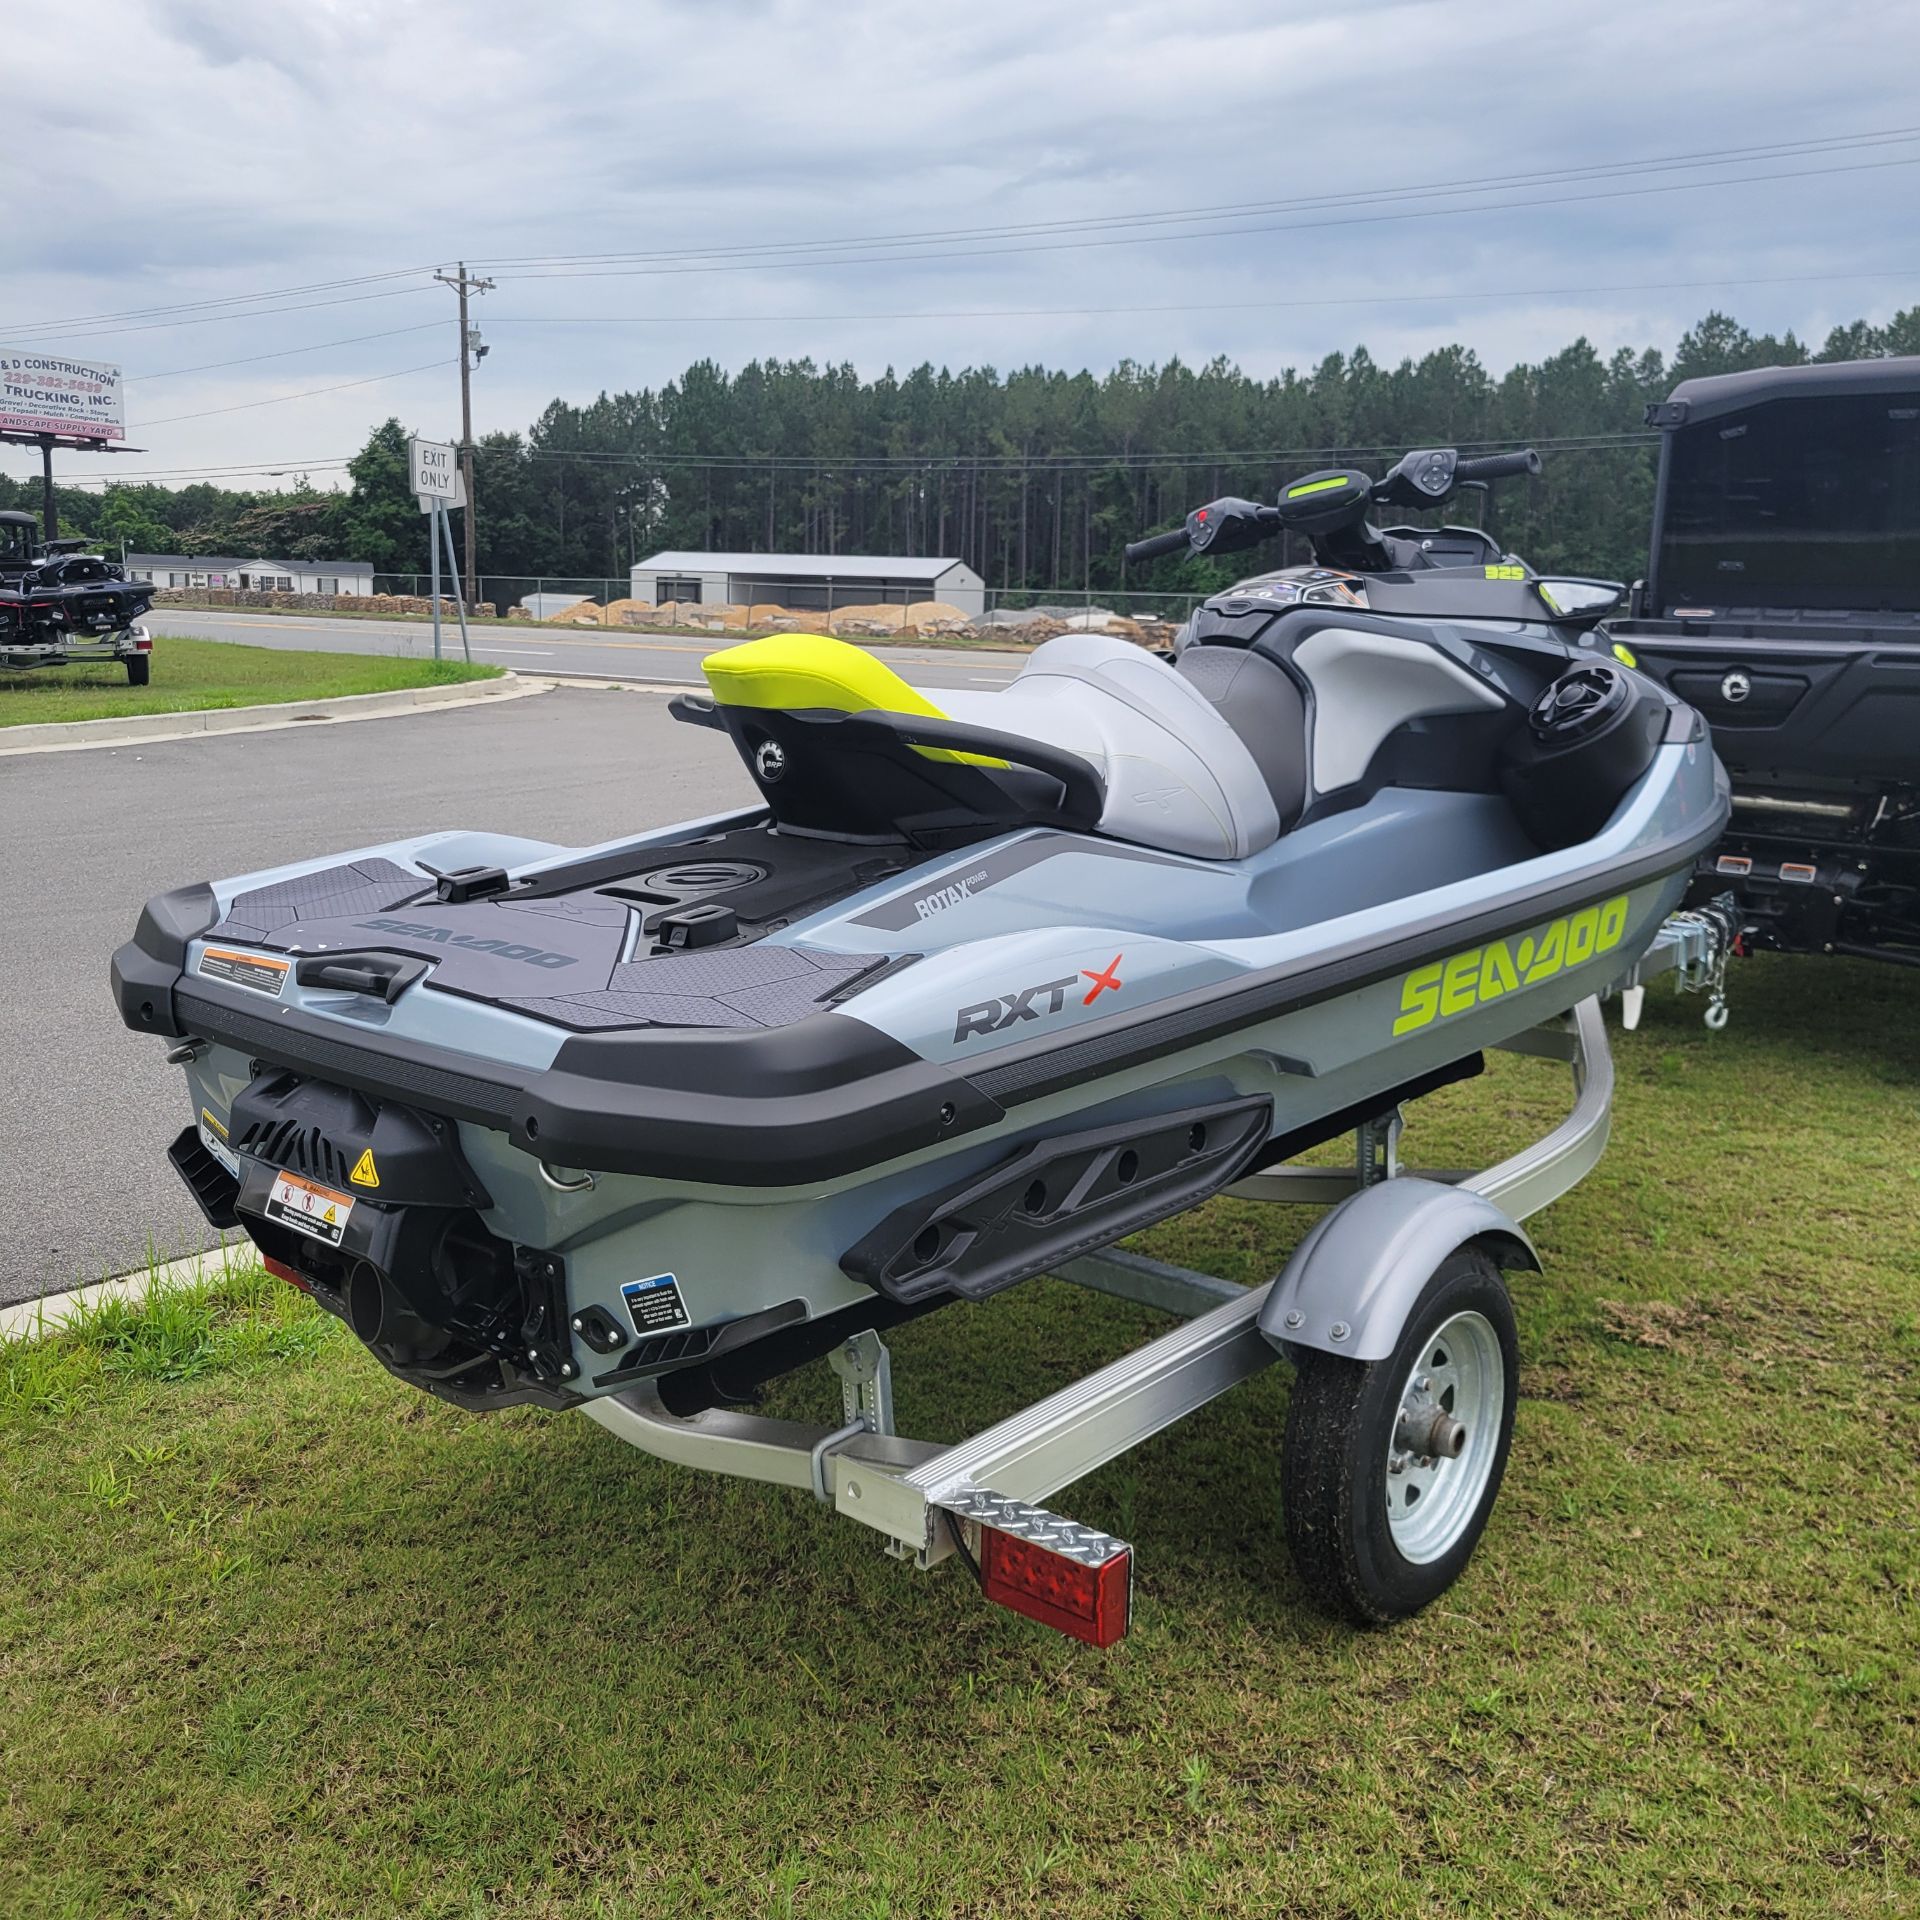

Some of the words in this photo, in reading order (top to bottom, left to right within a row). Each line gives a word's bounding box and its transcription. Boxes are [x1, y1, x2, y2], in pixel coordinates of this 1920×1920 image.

[0, 360, 10, 370] &
[12, 360, 20, 369] D
[24, 360, 115, 387] CONSTRUCTION
[4, 384, 84, 406] TRUCKING,
[88, 396, 116, 406] INC.
[12, 406, 38, 415] Topsoil
[70, 413, 99, 422] Compost
[28, 402, 66, 411] Decorative
[0, 417, 52, 428] ANDSCAPE
[54, 422, 88, 432] SUPPLY
[90, 426, 112, 436] YARD
[423, 450, 447, 468] EXIT
[422, 470, 450, 488] ONLY
[1484, 565, 1525, 580] 325
[766, 760, 782, 768] BRP
[914, 880, 974, 921] ROTAX
[966, 870, 988, 888] POWER
[953, 974, 1078, 1044] RXT
[638, 1280, 656, 1290] NOTICE
